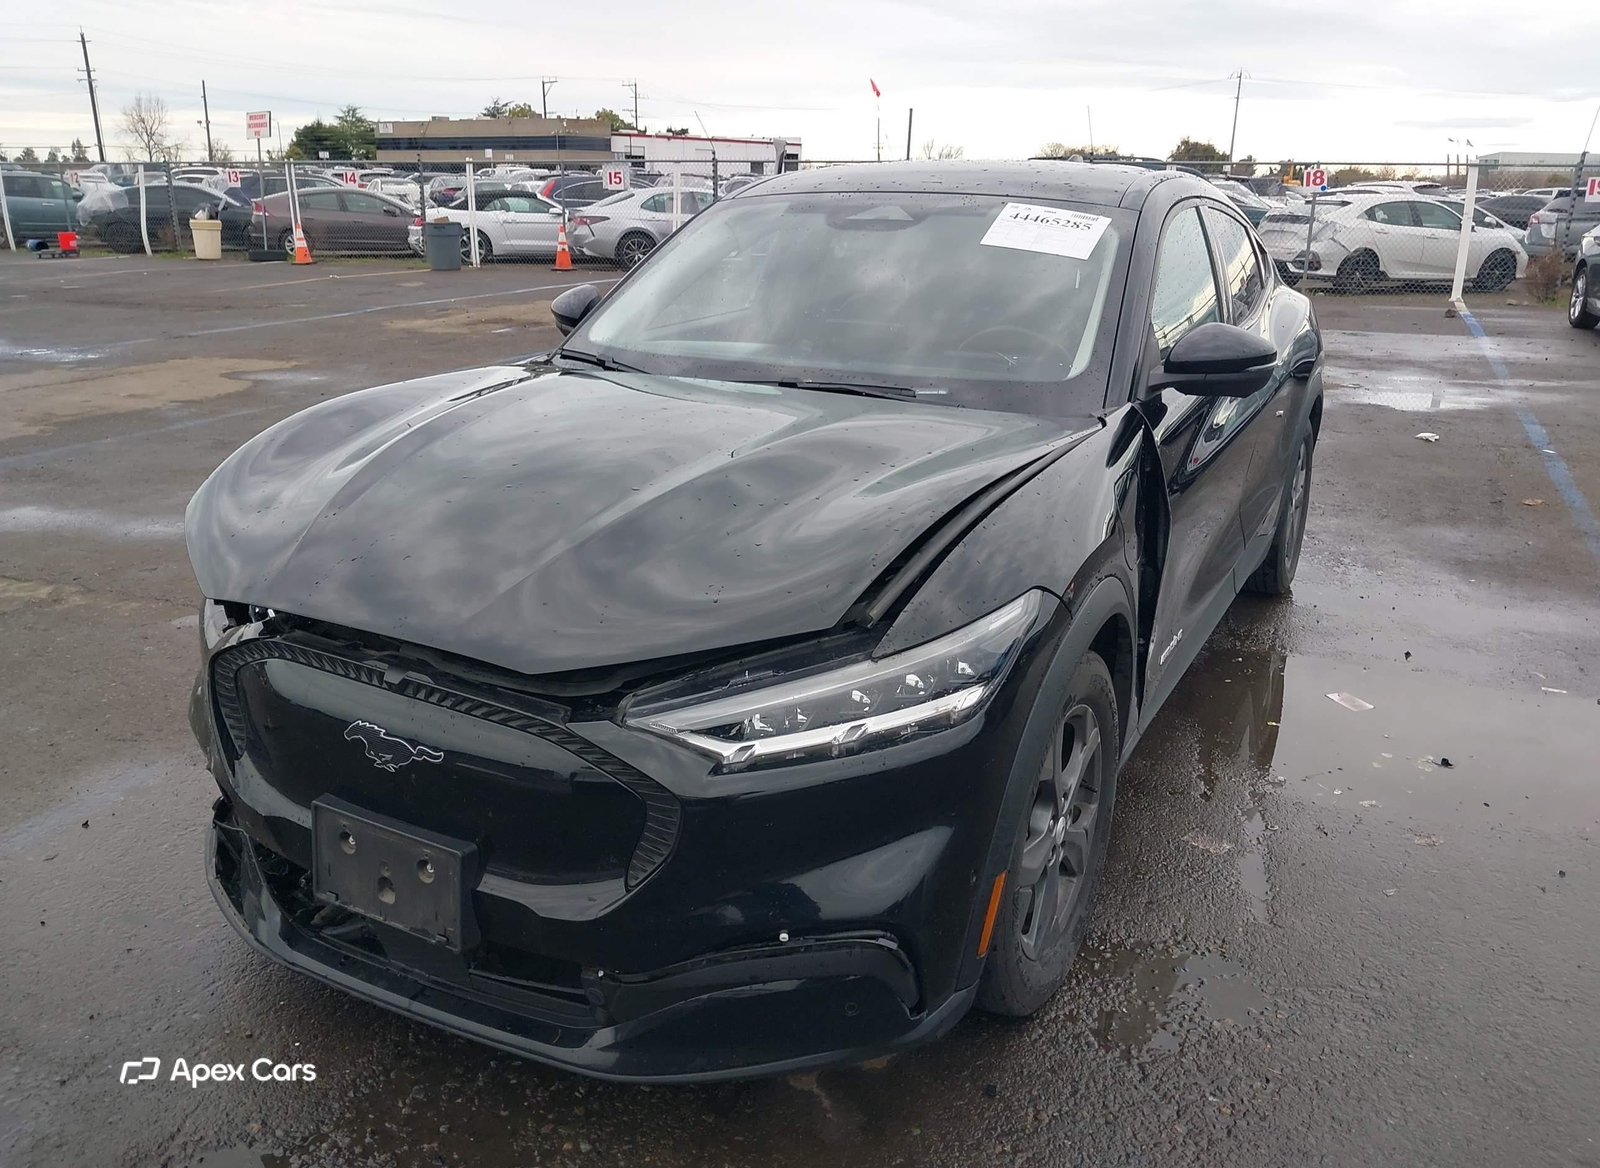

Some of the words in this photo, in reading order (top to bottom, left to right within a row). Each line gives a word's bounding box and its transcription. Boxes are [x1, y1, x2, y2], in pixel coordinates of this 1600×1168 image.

[228, 171, 239, 183] 13
[345, 172, 357, 184] 14
[608, 171, 622, 185] 15
[1306, 170, 1325, 187] 18
[1588, 179, 1600, 196] 1
[1009, 212, 1093, 231] 44465285
